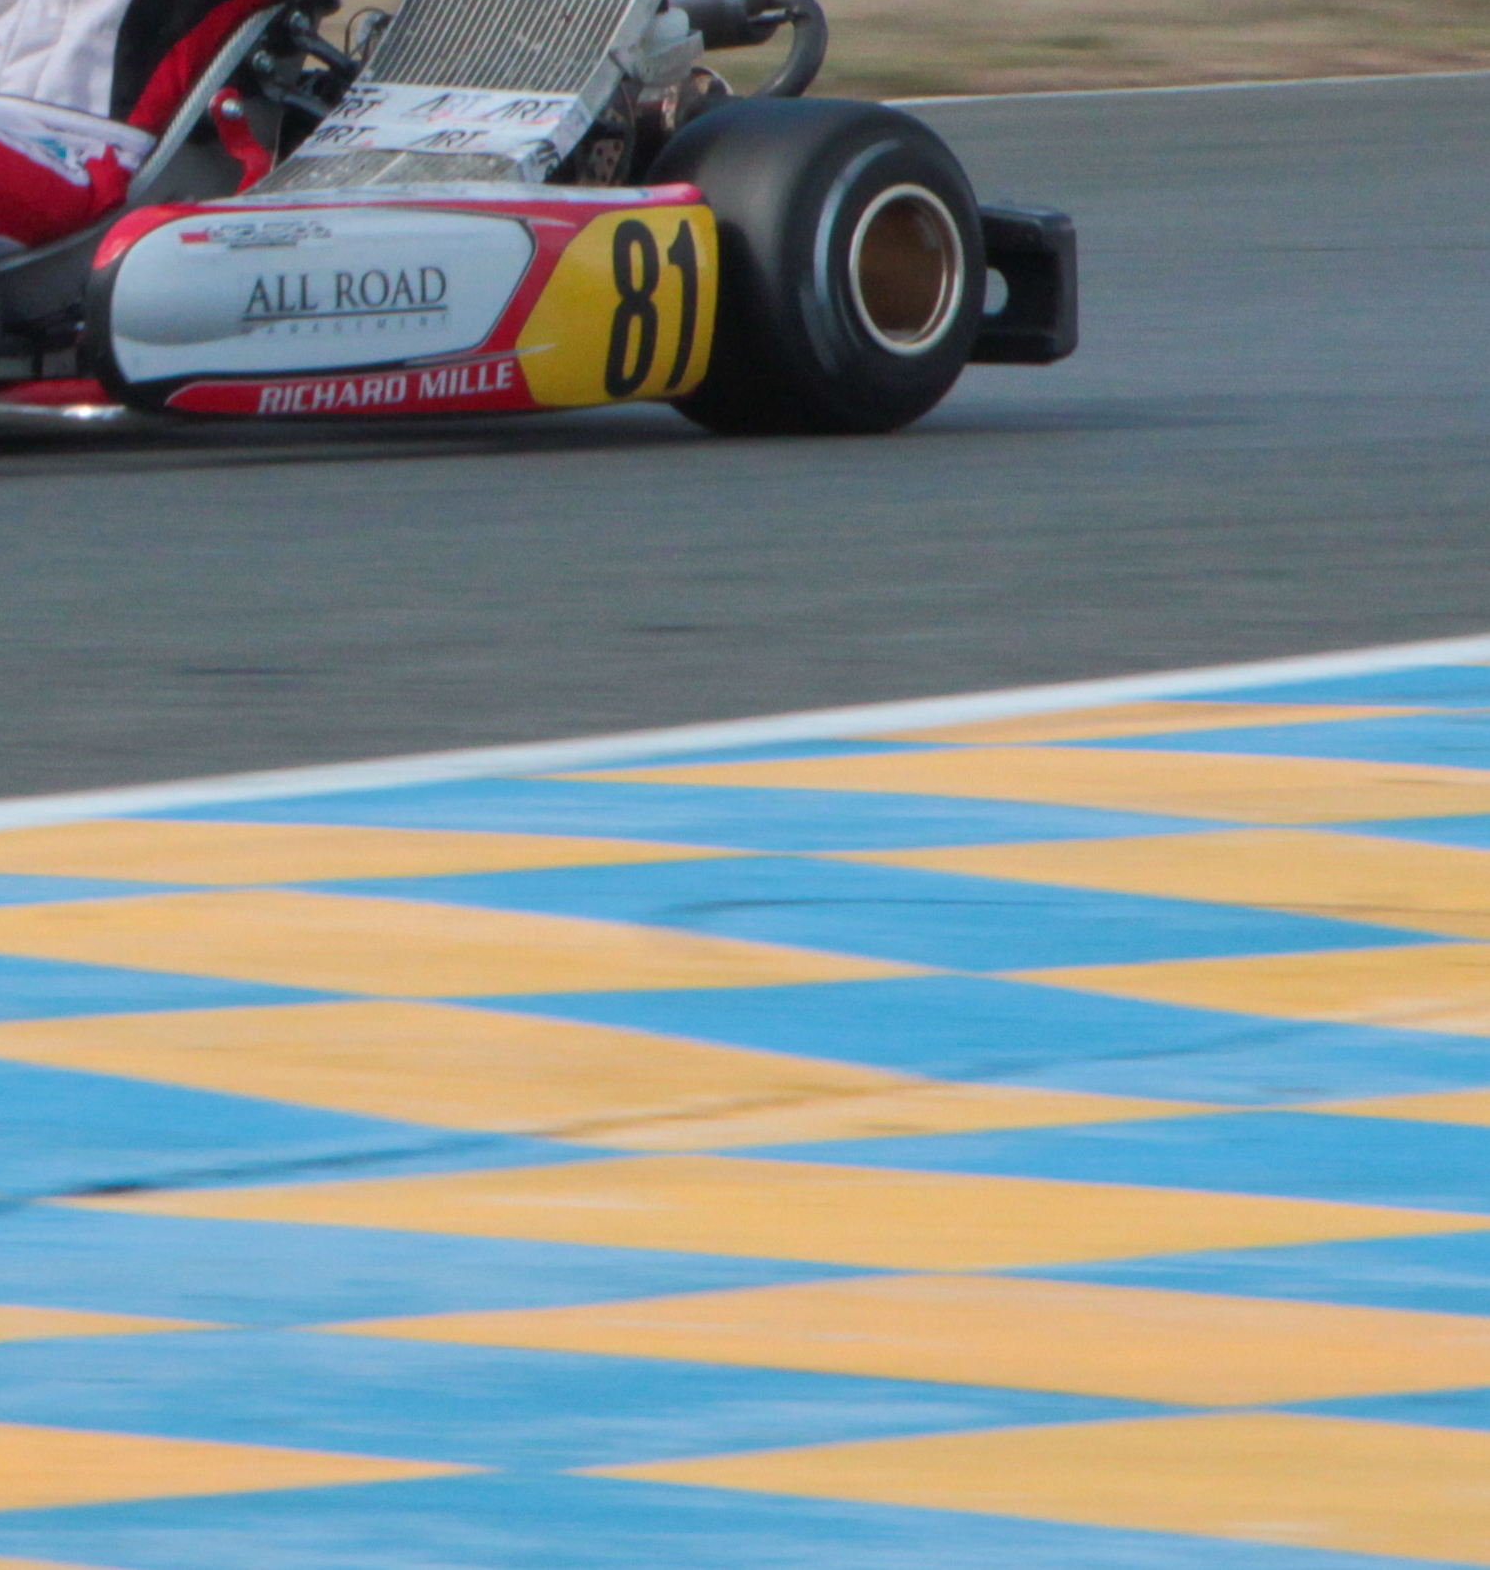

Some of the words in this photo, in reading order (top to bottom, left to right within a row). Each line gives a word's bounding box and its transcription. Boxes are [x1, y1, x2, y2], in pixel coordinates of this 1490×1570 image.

[482, 99, 566, 121] ART
[408, 130, 491, 148] ART
[245, 273, 319, 314] ALL
[333, 266, 448, 310] ROAD
[605, 219, 699, 398] 81
[256, 375, 408, 415] RICHARD
[417, 361, 515, 402] MILLE
